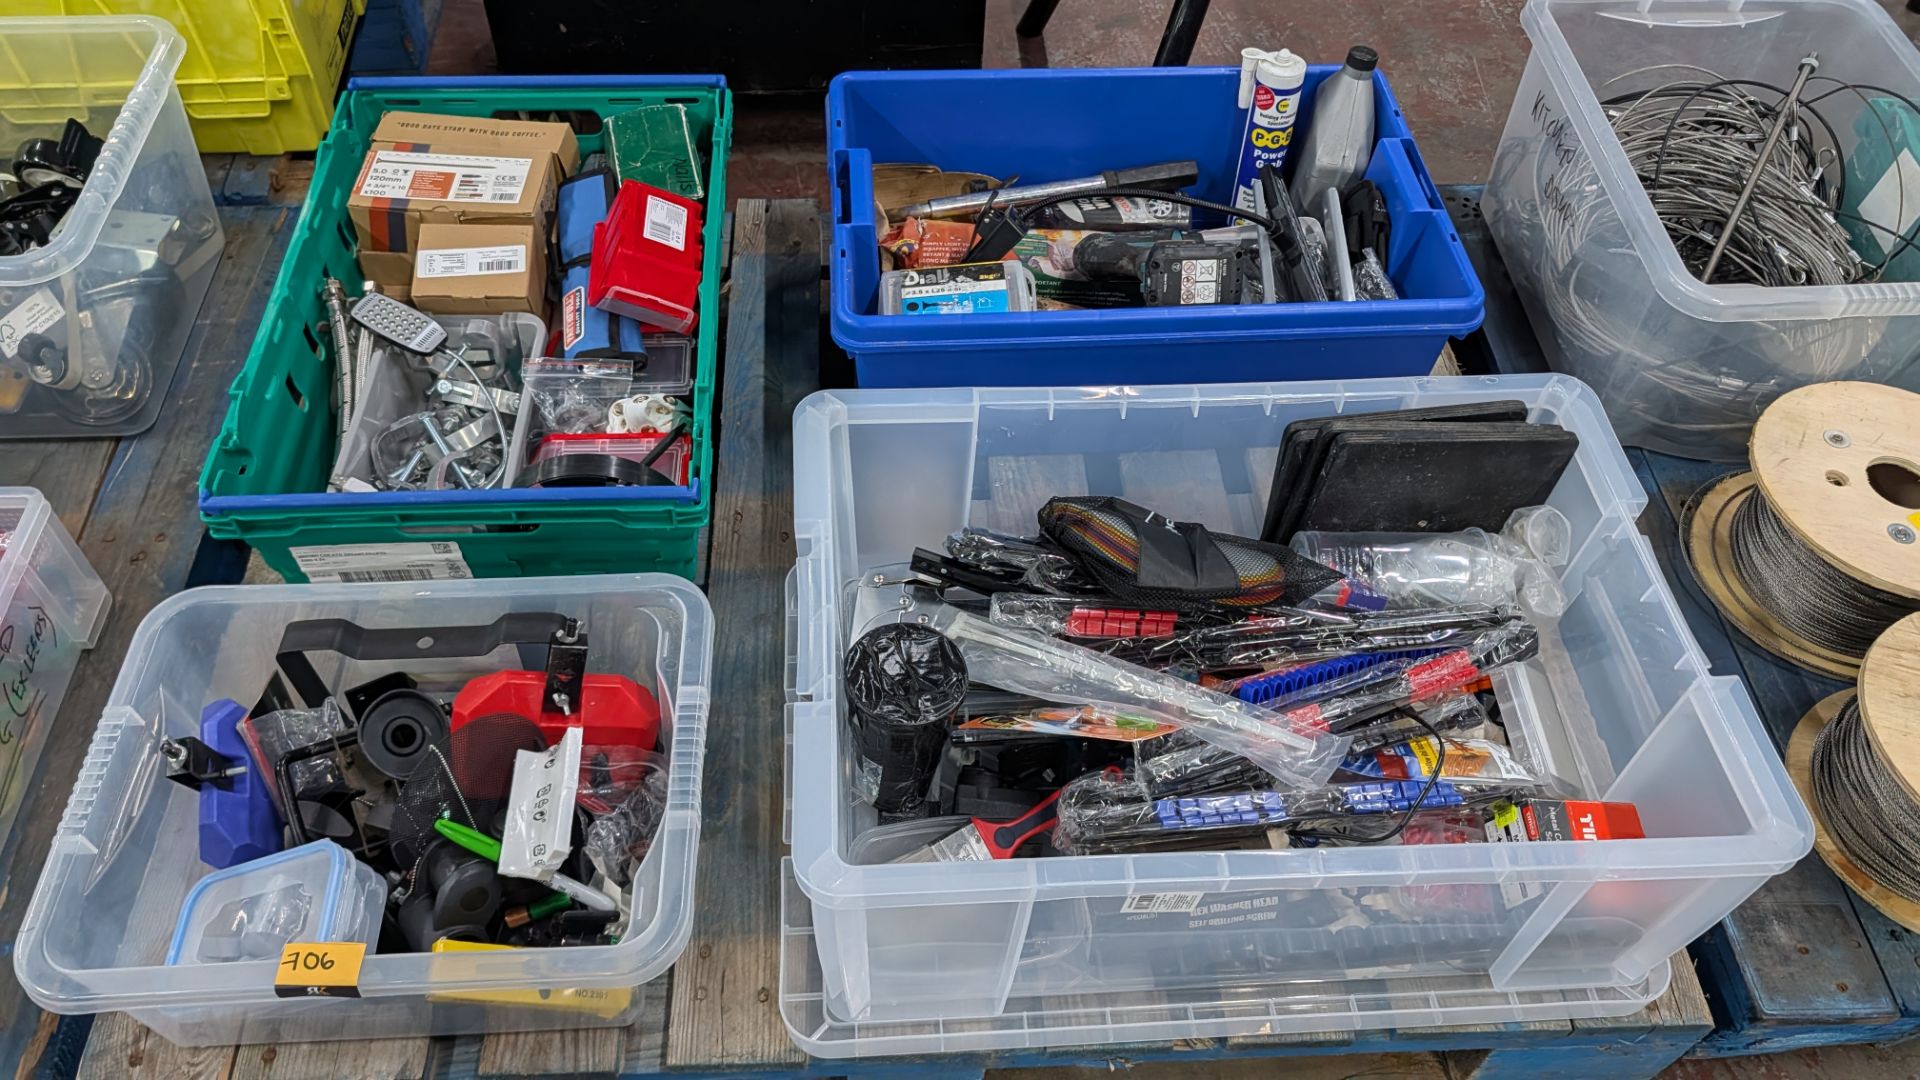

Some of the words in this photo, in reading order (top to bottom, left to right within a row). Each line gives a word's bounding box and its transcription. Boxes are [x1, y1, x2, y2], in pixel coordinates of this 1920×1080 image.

[443, 125, 467, 133] START
[1253, 148, 1288, 160] Power
[369, 175, 402, 183] 120mm
[1526, 811, 1535, 836] timco
[1548, 806, 1560, 831] Metal
[1210, 900, 1251, 914] WASHER
[1253, 896, 1279, 909] HEAD
[1189, 919, 1208, 928] SELF
[1208, 915, 1244, 926] DRILLING
[1245, 911, 1277, 922] SCREW
[281, 951, 335, 971] 706
